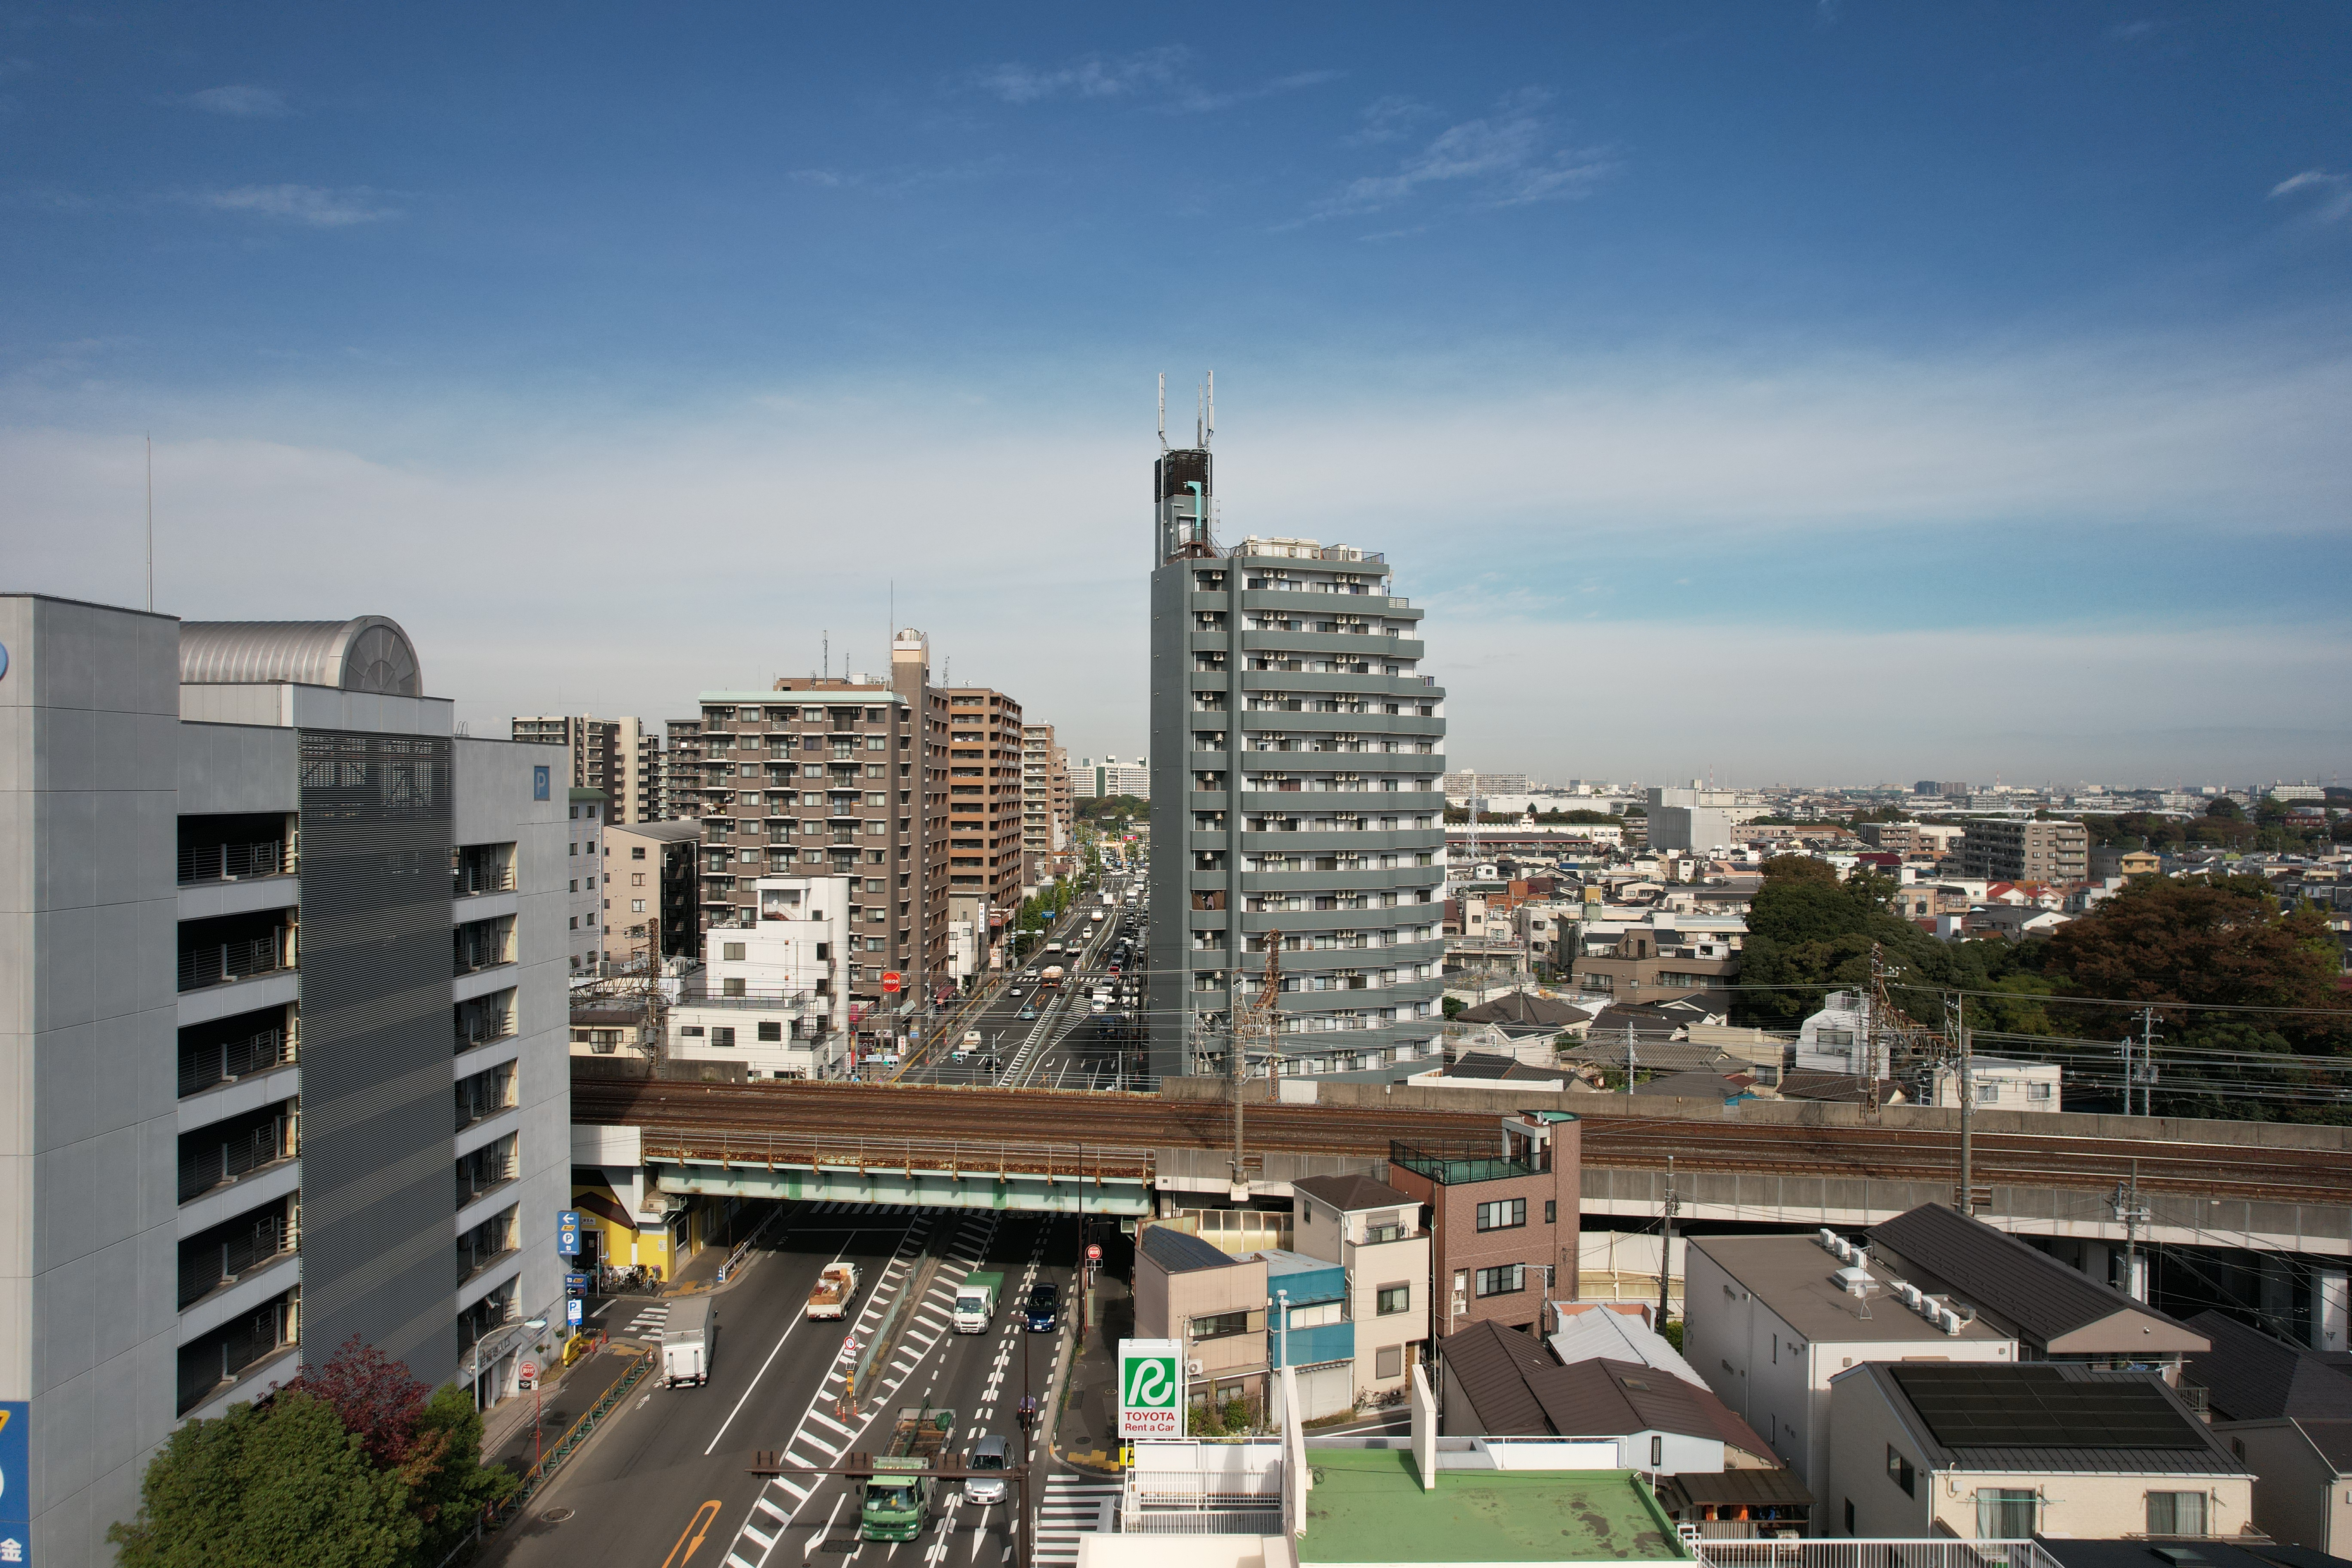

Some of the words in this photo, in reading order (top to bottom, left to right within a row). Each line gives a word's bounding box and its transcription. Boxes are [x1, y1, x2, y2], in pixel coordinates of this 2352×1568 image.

[537, 772, 546, 795] P
[570, 1302, 577, 1311] P
[1125, 1412, 1175, 1421] TOYOTA
[0, 1538, 22, 1561] 金
